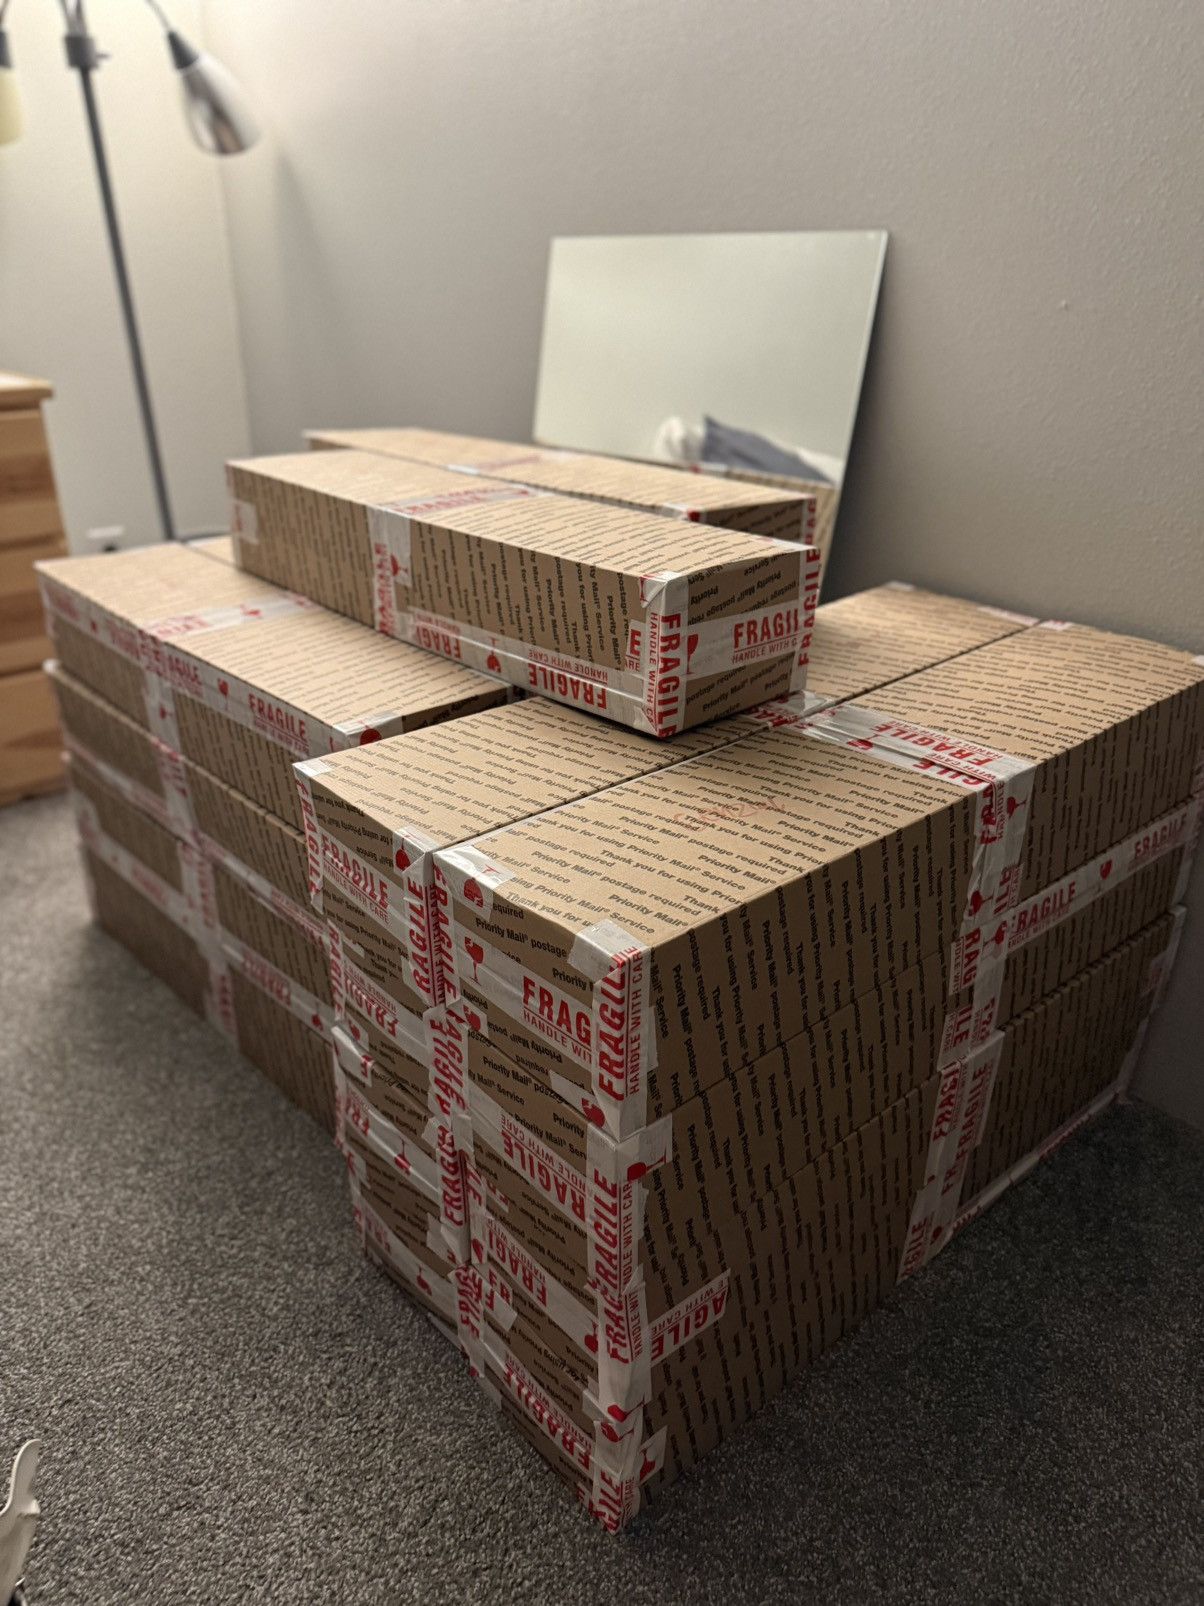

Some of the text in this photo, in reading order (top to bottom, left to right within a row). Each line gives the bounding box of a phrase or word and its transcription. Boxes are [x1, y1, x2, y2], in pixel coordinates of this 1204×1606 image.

[528, 649, 608, 681] HANDLE WITH CARE
[646, 611, 658, 708] HANDLE WITH
[658, 612, 681, 739] FRAGILE
[731, 641, 789, 665] HANDLE WITH
[528, 662, 607, 710] FRAGILE
[870, 722, 993, 767] FRAGILE
[493, 902, 524, 919] equired
[1016, 881, 1076, 933] RAGILE
[408, 876, 432, 994] RAGILE
[522, 975, 591, 1048] FRAG
[630, 988, 642, 1032] WITH
[572, 1044, 592, 1065] WIT
[629, 1033, 641, 1095] HANDLE
[501, 1129, 586, 1223] RAGILE
[623, 1183, 633, 1210] CAR
[490, 1228, 547, 1307] FRAGI
[651, 1289, 726, 1361] AGILE
